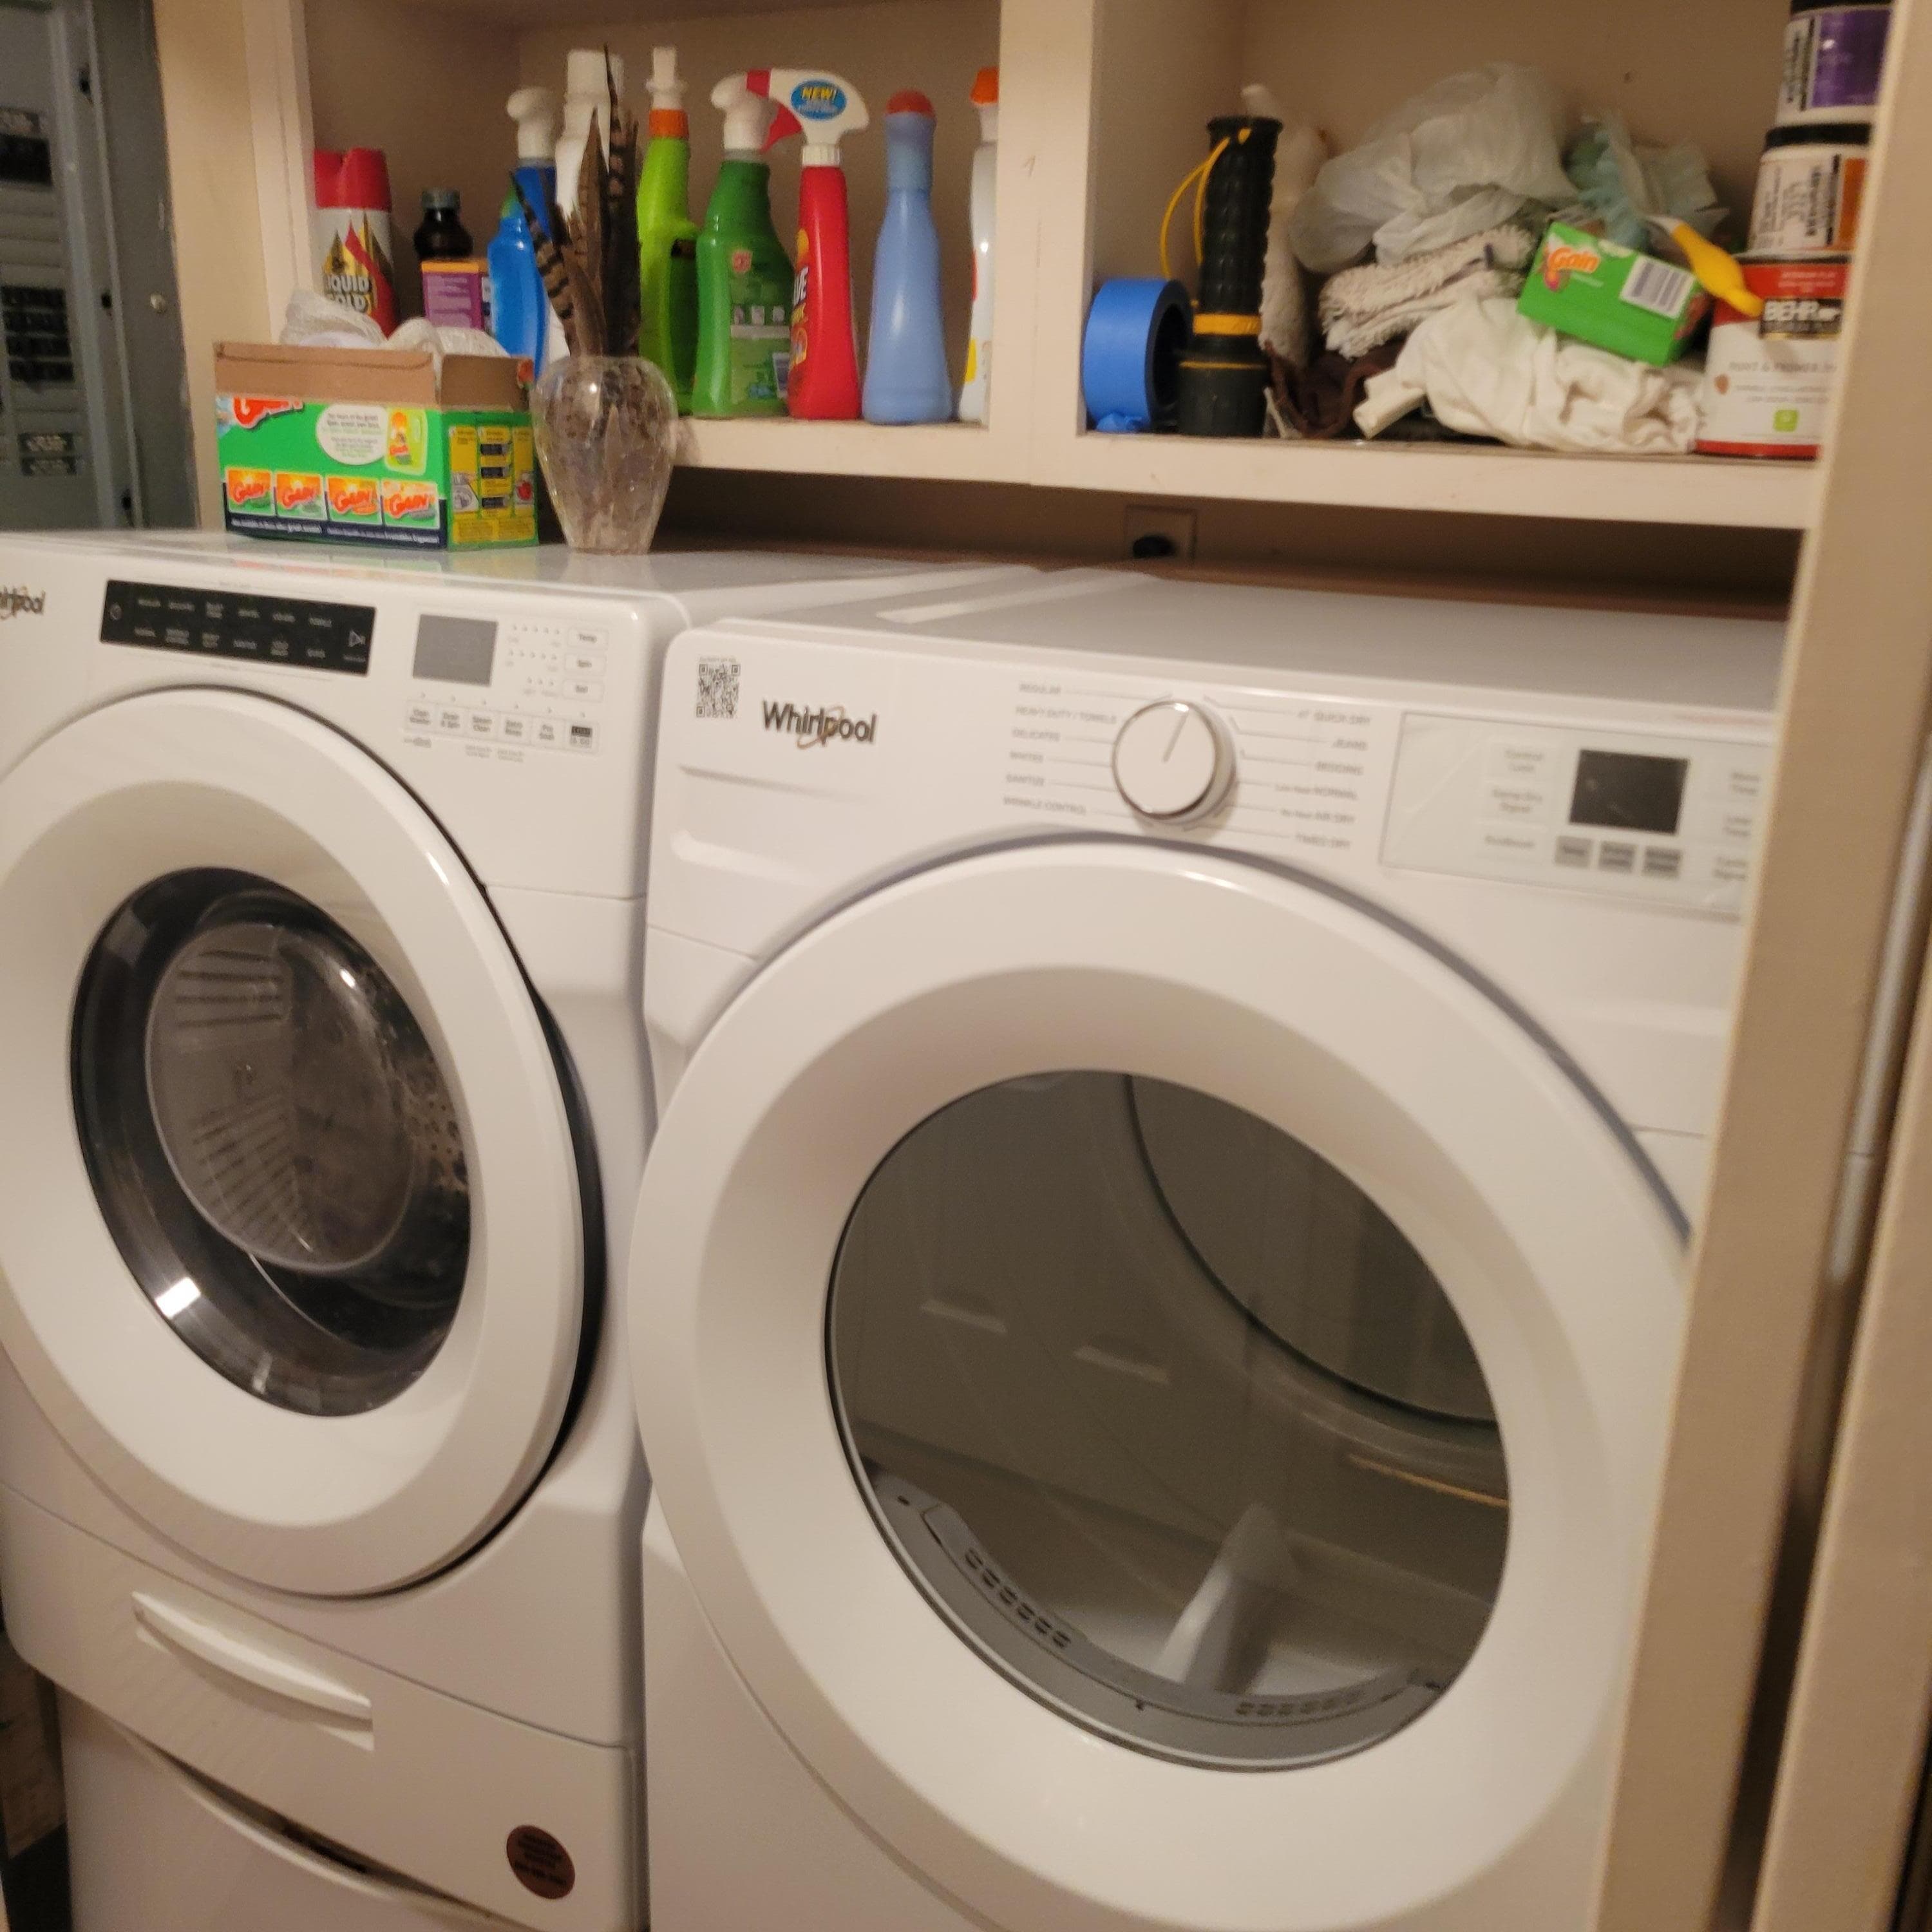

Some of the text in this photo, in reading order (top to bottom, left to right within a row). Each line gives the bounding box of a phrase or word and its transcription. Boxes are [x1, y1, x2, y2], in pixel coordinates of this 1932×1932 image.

[802, 86, 838, 103] NEW!
[1765, 299, 1819, 321] BEHR
[762, 698, 877, 748] Whirlpool
